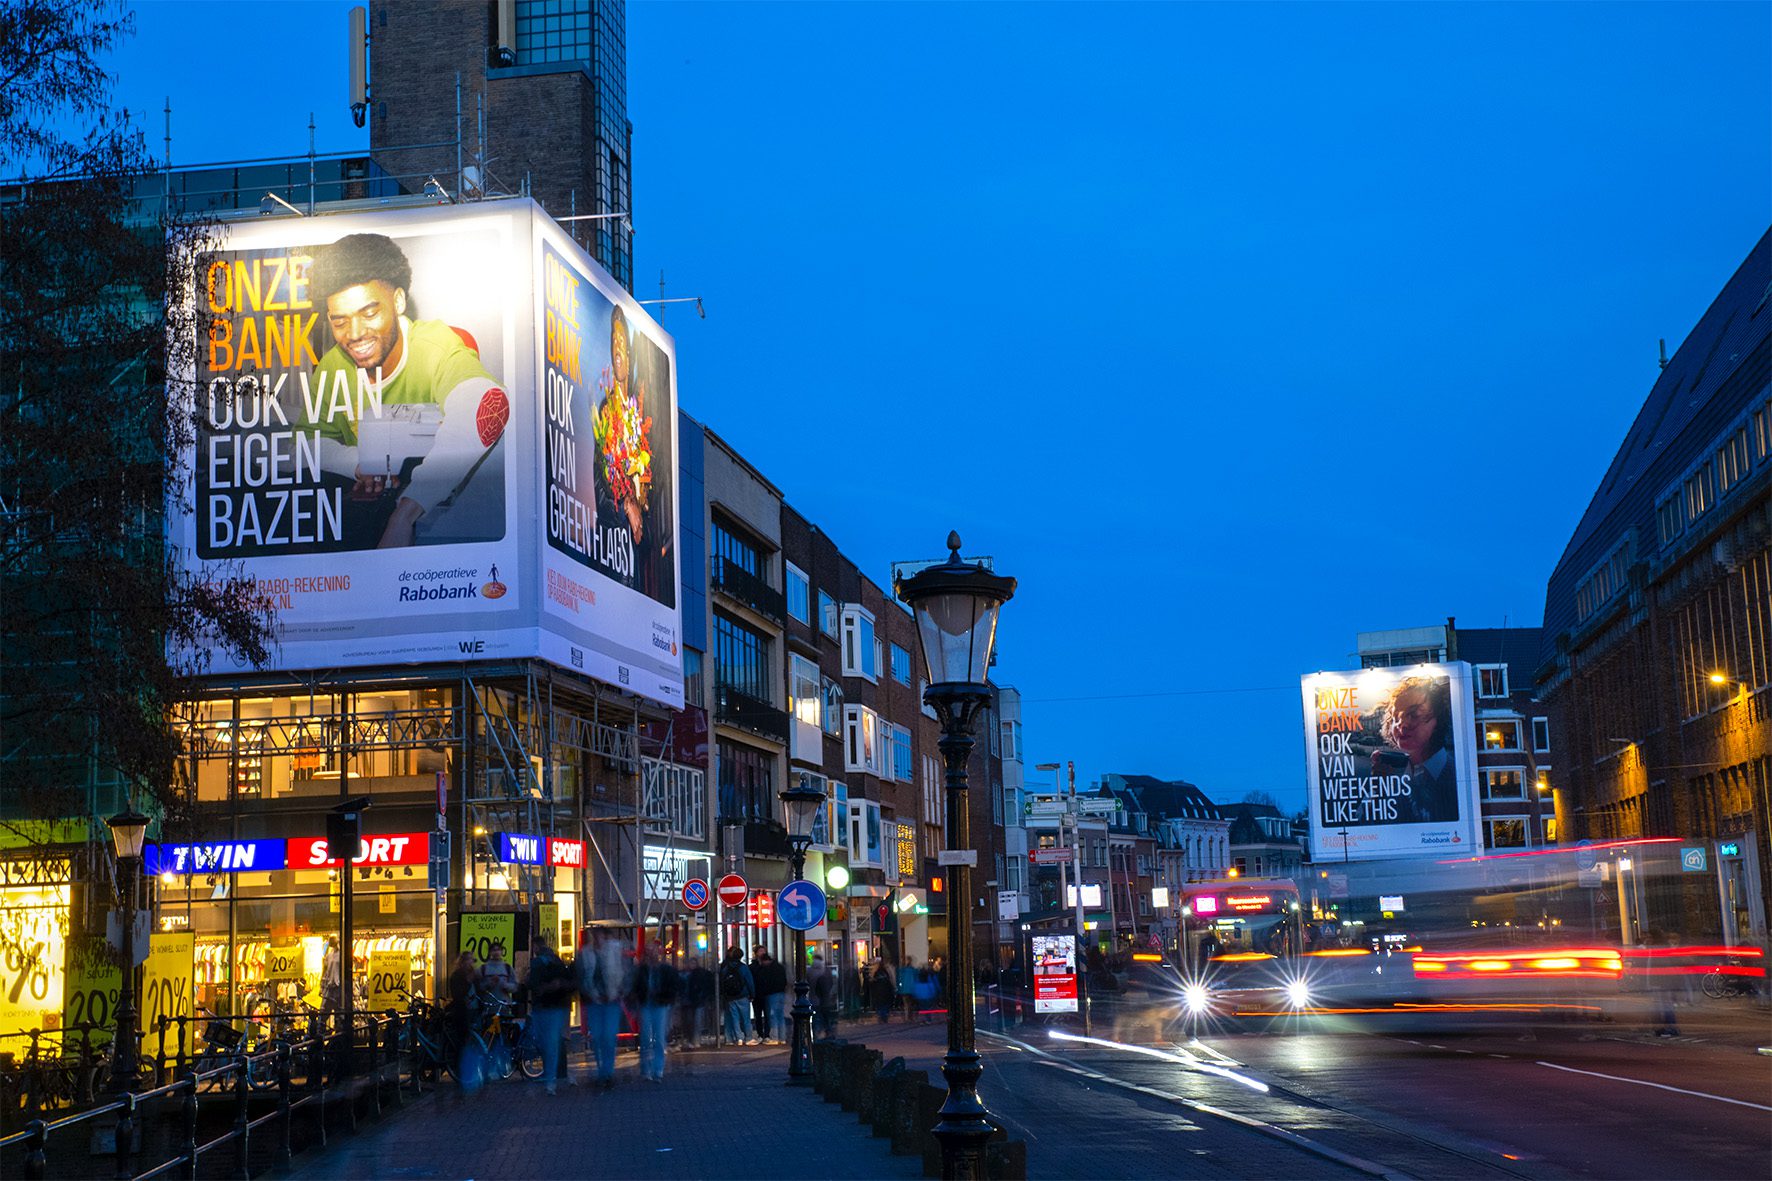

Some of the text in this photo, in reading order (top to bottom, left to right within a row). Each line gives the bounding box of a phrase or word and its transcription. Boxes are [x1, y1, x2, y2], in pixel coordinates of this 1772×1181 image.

[207, 255, 313, 314] ONZE
[545, 252, 580, 330] ONZE
[208, 312, 320, 371] BANK
[546, 307, 583, 386] BANK
[208, 366, 383, 431] OOK VAN
[547, 368, 575, 436] OOK
[209, 430, 322, 489] EIGEN
[549, 424, 576, 493] VAN
[209, 487, 342, 548] BAZEN
[549, 483, 592, 559] GREEN
[258, 574, 351, 594] RABO-REKENING
[398, 567, 478, 584] de coöperatieve
[399, 583, 477, 602] Rabobank
[1318, 687, 1359, 711] ONZE
[1319, 710, 1364, 733] BANK
[1320, 733, 1353, 756] OOK
[1321, 755, 1356, 778] VAN
[1322, 774, 1412, 800] WEEKENDS
[1324, 798, 1398, 823] LIKE THIS
[173, 836, 409, 871] TWIN SORT
[509, 836, 583, 865] TWIN SPORT
[270, 956, 297, 972] 20%
[373, 972, 407, 994] 20%
[148, 976, 188, 1034] 20%
